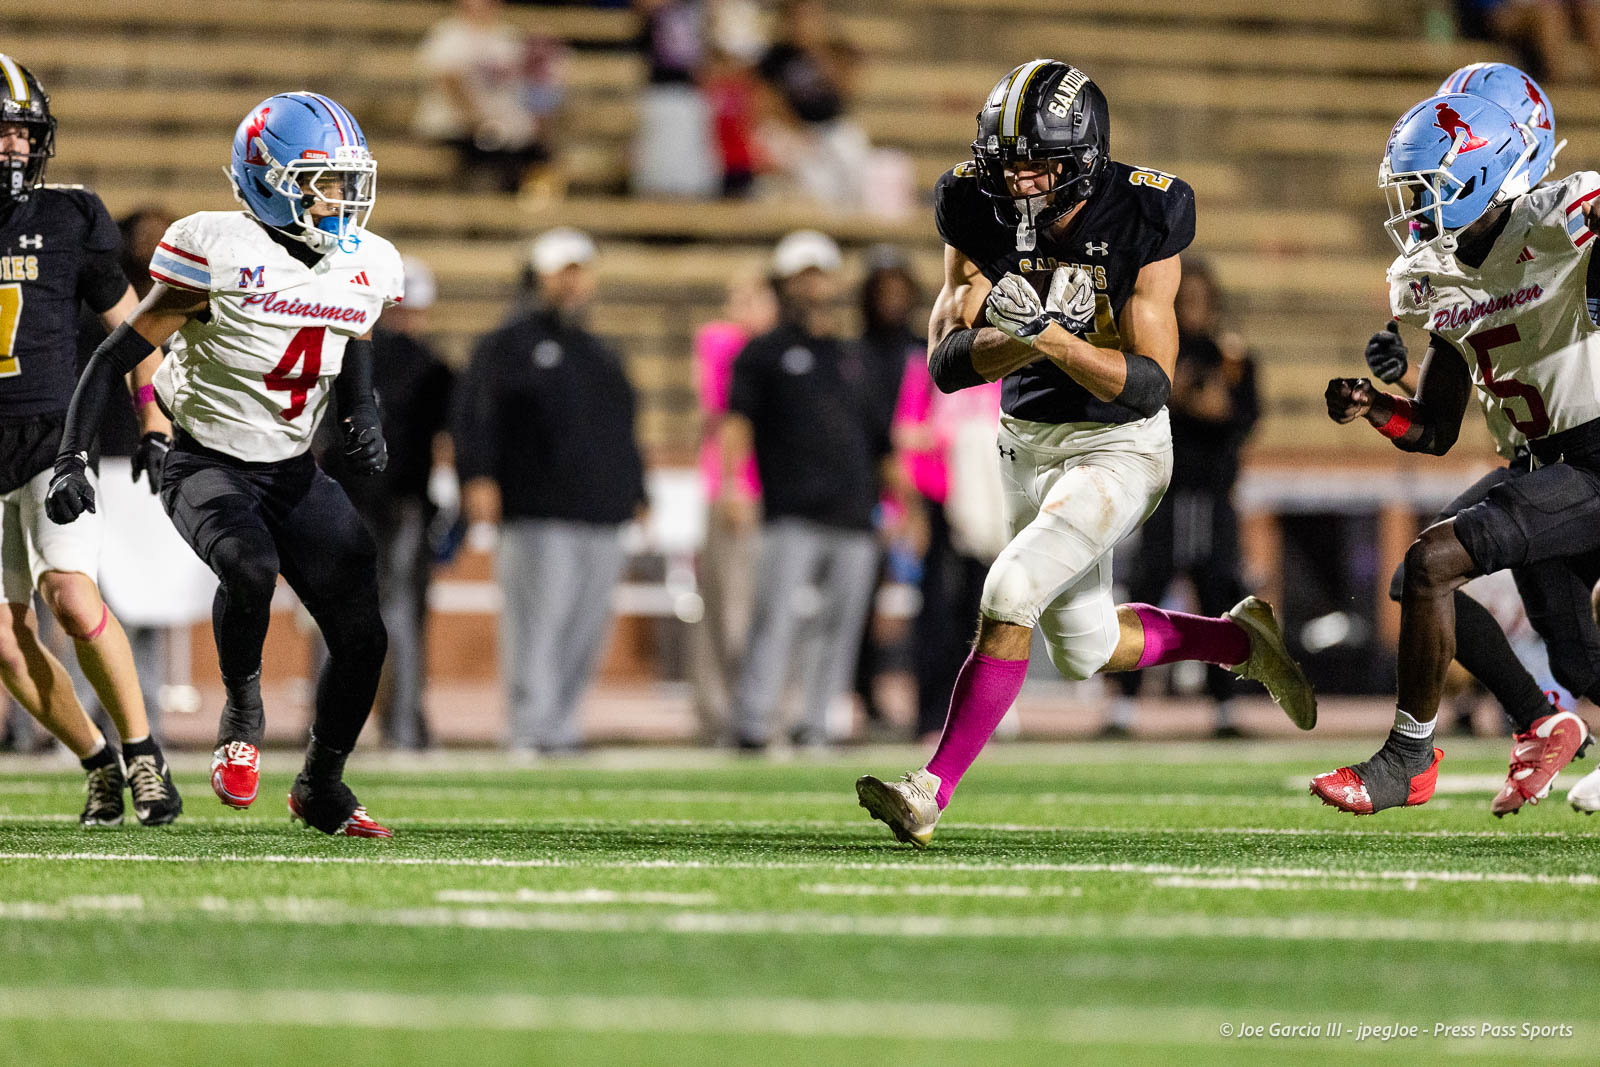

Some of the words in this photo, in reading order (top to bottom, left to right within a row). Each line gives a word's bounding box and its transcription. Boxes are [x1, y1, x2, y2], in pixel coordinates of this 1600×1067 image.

[0, 255, 39, 280] IES
[239, 265, 265, 288] M
[1409, 275, 1437, 305] M
[240, 291, 368, 324] Plainsmen
[1433, 283, 1545, 333] Plainsmen
[262, 326, 326, 421] 4
[1465, 323, 1550, 440] 5
